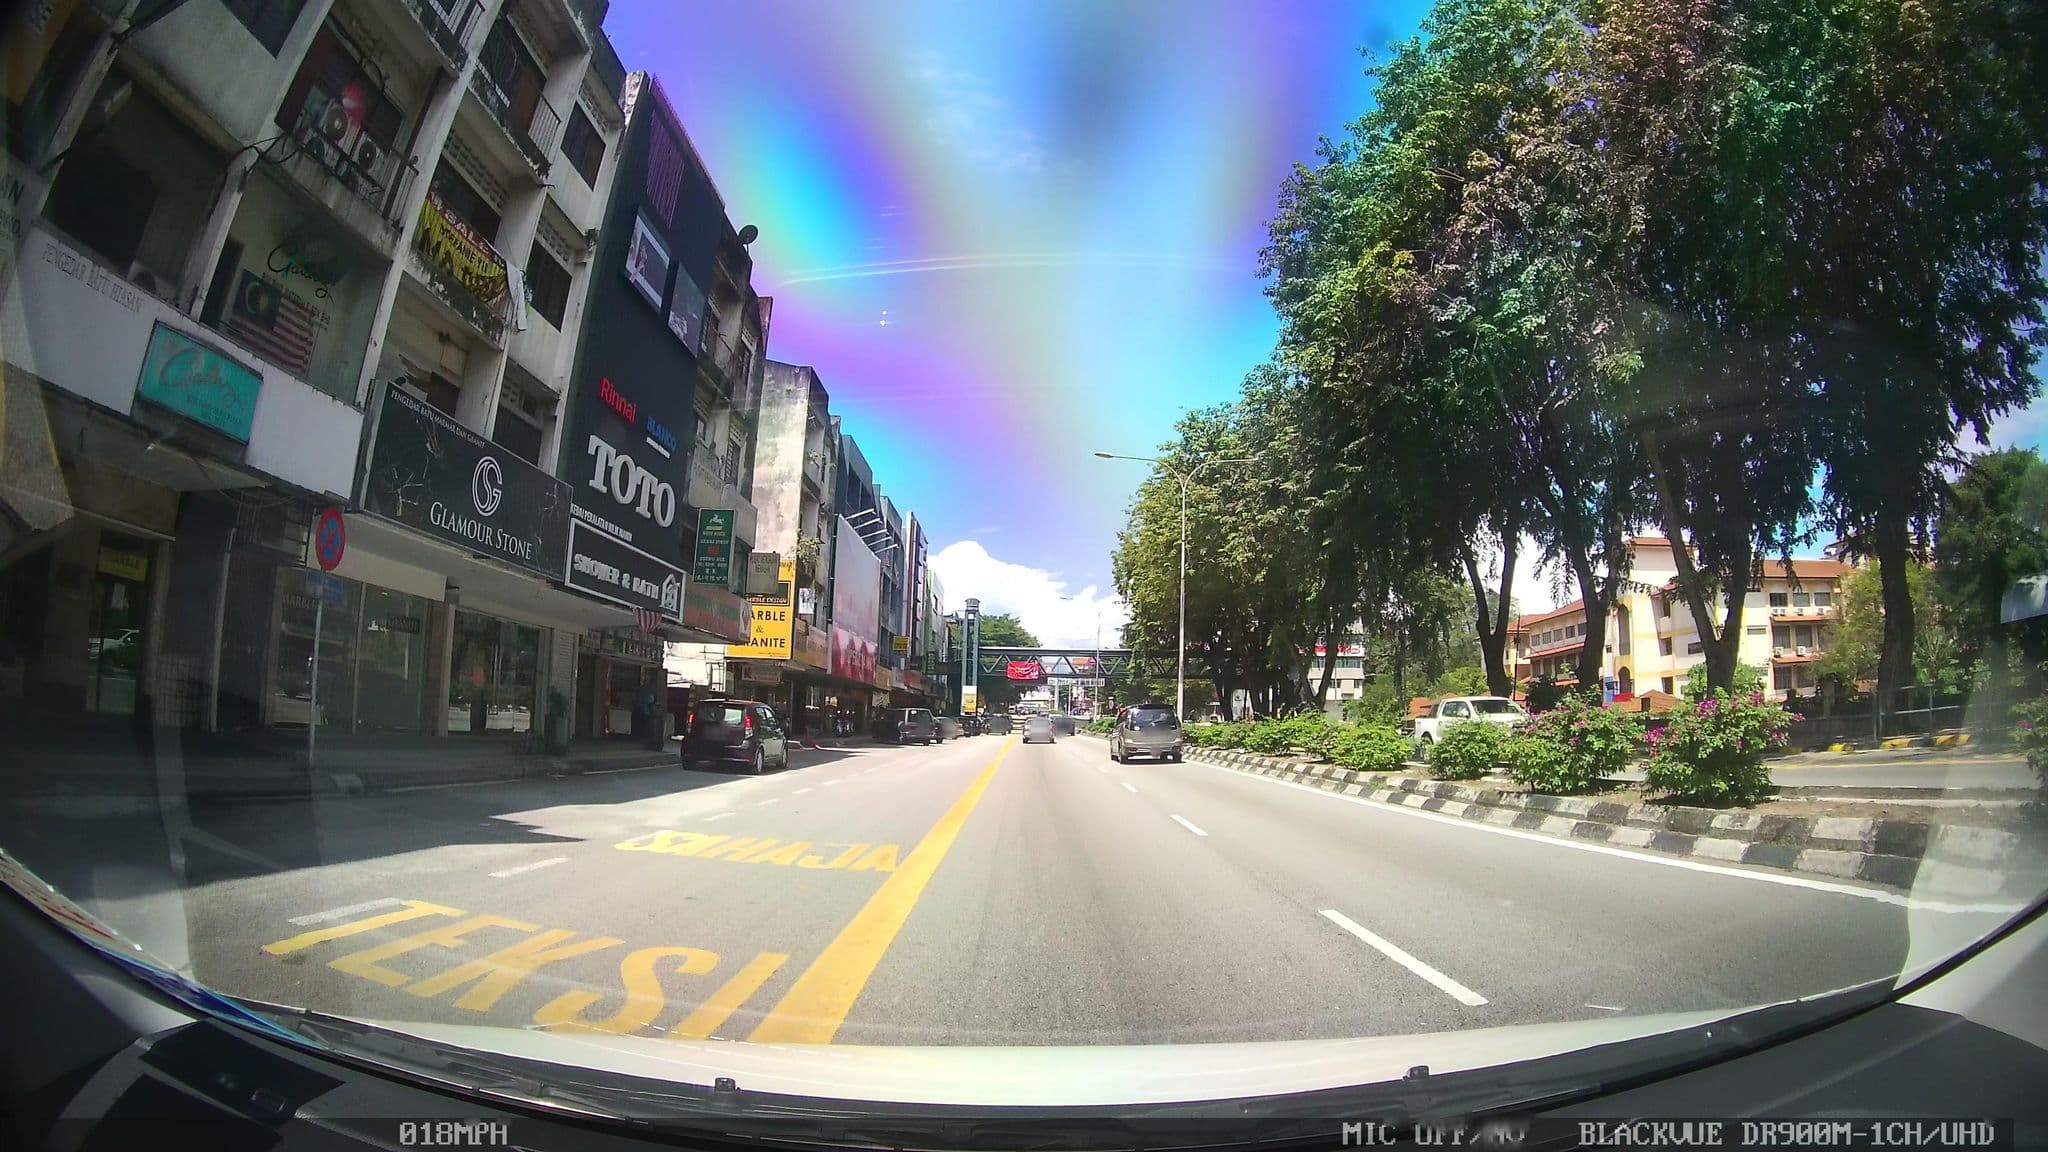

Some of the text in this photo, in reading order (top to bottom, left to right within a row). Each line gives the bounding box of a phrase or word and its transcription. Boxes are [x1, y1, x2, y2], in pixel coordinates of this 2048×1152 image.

[600, 377, 637, 424] Rinnai
[646, 416, 677, 451] BLANCO
[587, 434, 676, 528] TOTO
[430, 501, 532, 560] GLAMOUR STONE
[574, 553, 660, 600] SHOWER & BATH
[750, 610, 786, 621] ARBLE
[612, 829, 900, 872] SAHAJA
[261, 899, 790, 1040] TEKSI
